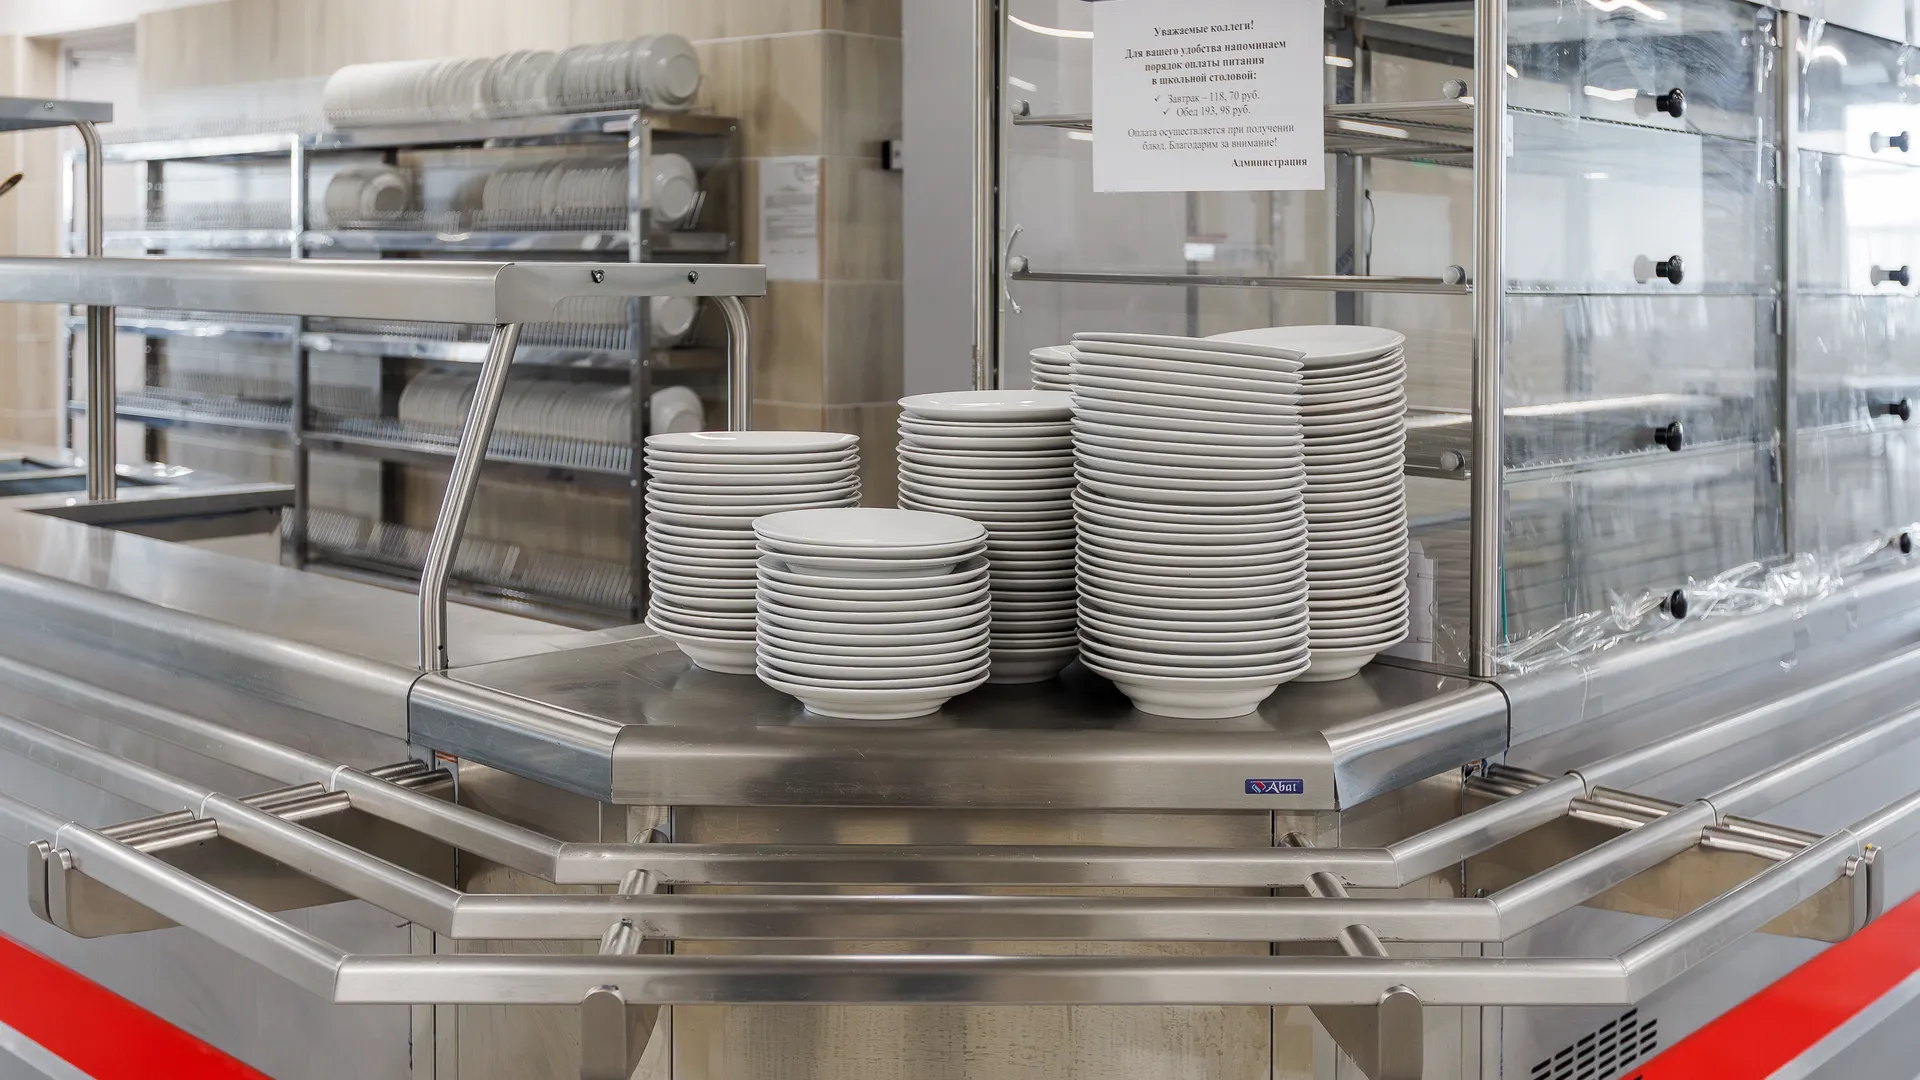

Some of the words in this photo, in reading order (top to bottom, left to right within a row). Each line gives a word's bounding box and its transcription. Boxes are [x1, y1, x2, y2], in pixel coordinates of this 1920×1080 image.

[1154, 25, 1208, 37] Уважаемые
[1211, 20, 1254, 33] коллеги!
[1125, 49, 1143, 59] Для
[1146, 47, 1178, 57] вашего
[1224, 40, 1286, 51] напоминаем
[1145, 61, 1182, 73] порядок
[1185, 59, 1220, 68] оплаты
[1223, 57, 1264, 66] питания
[1160, 73, 1206, 84] школьной
[1209, 71, 1256, 82] столовой:
[1177, 107, 1198, 118] Обед
[1201, 106, 1218, 117] 193,
[1128, 127, 1157, 138] Оплата
[1228, 127, 1244, 136] при
[1169, 140, 1218, 151] Благодарим
[1232, 138, 1277, 148] внимание!
[1231, 158, 1307, 168] Администрация
[1265, 781, 1297, 794] Abat
